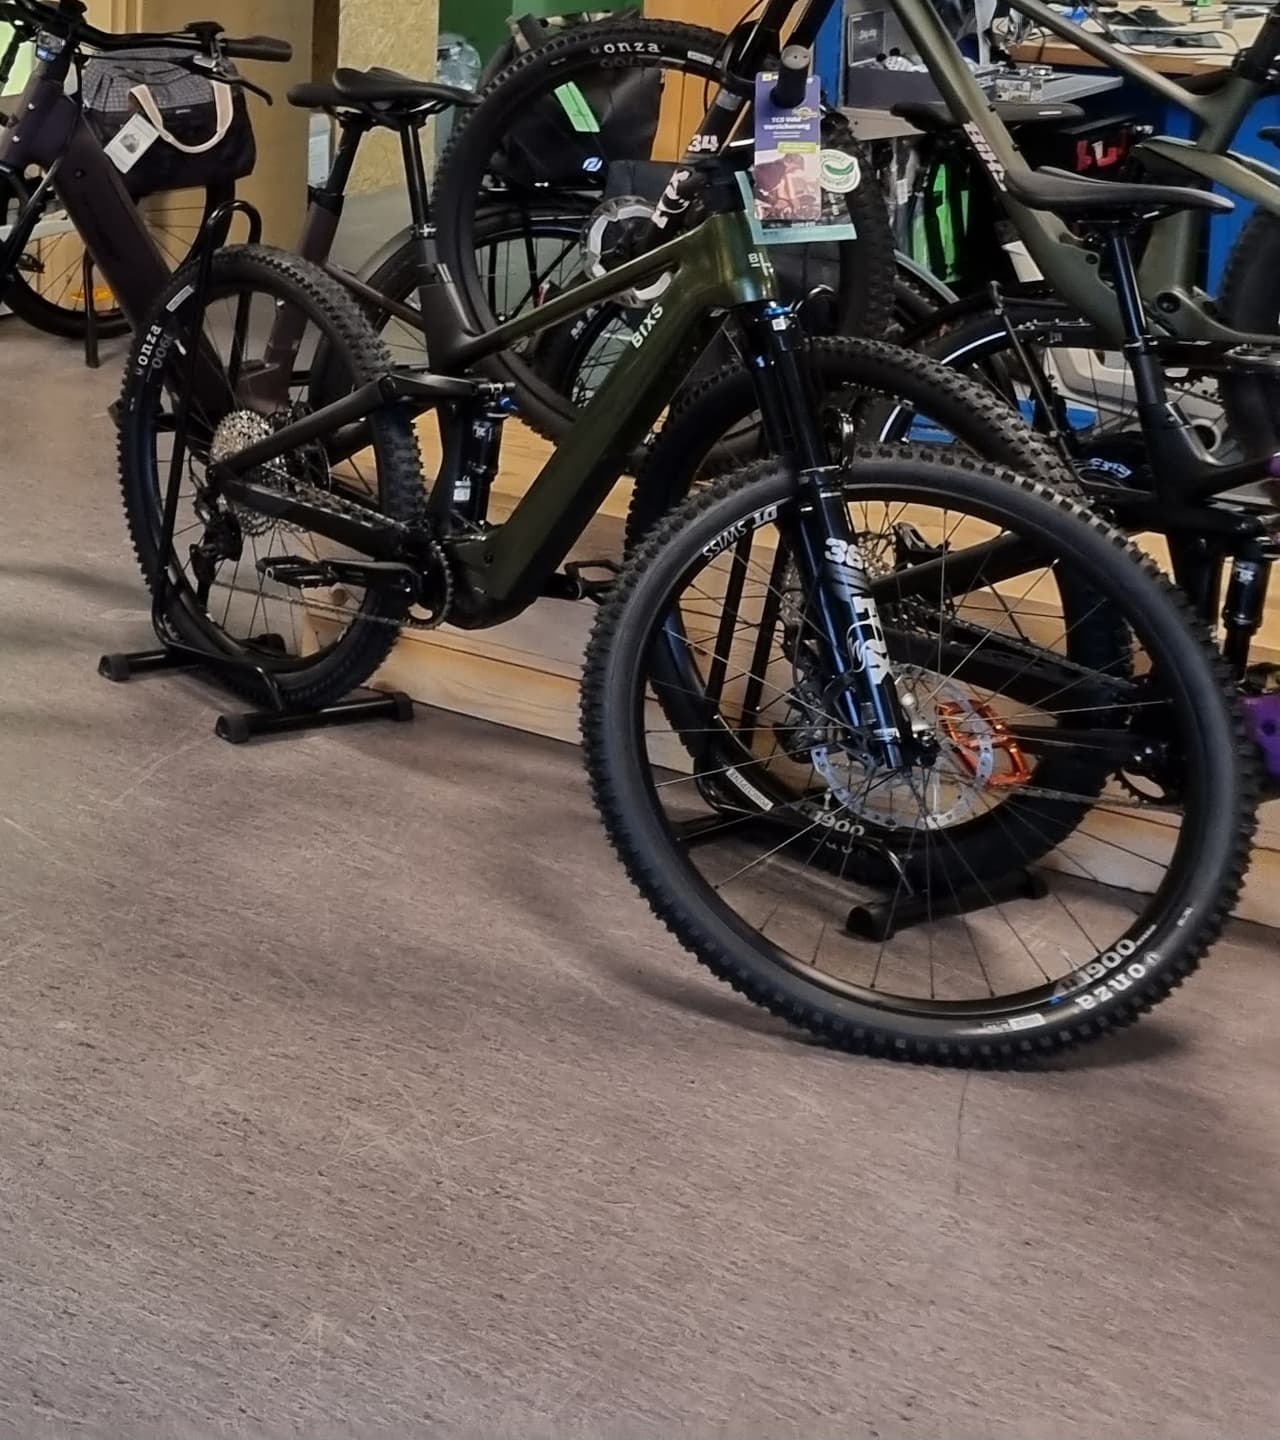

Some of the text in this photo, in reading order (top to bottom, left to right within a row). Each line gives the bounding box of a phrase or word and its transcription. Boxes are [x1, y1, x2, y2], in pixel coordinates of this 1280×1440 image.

[603, 41, 661, 54] onza
[687, 134, 719, 153] 34
[137, 324, 163, 366] onza
[631, 302, 664, 349] BIXS
[702, 504, 778, 561] DT SWISS
[824, 536, 864, 570] 36
[1078, 938, 1137, 984] 1900
[1074, 963, 1147, 1011] onza
